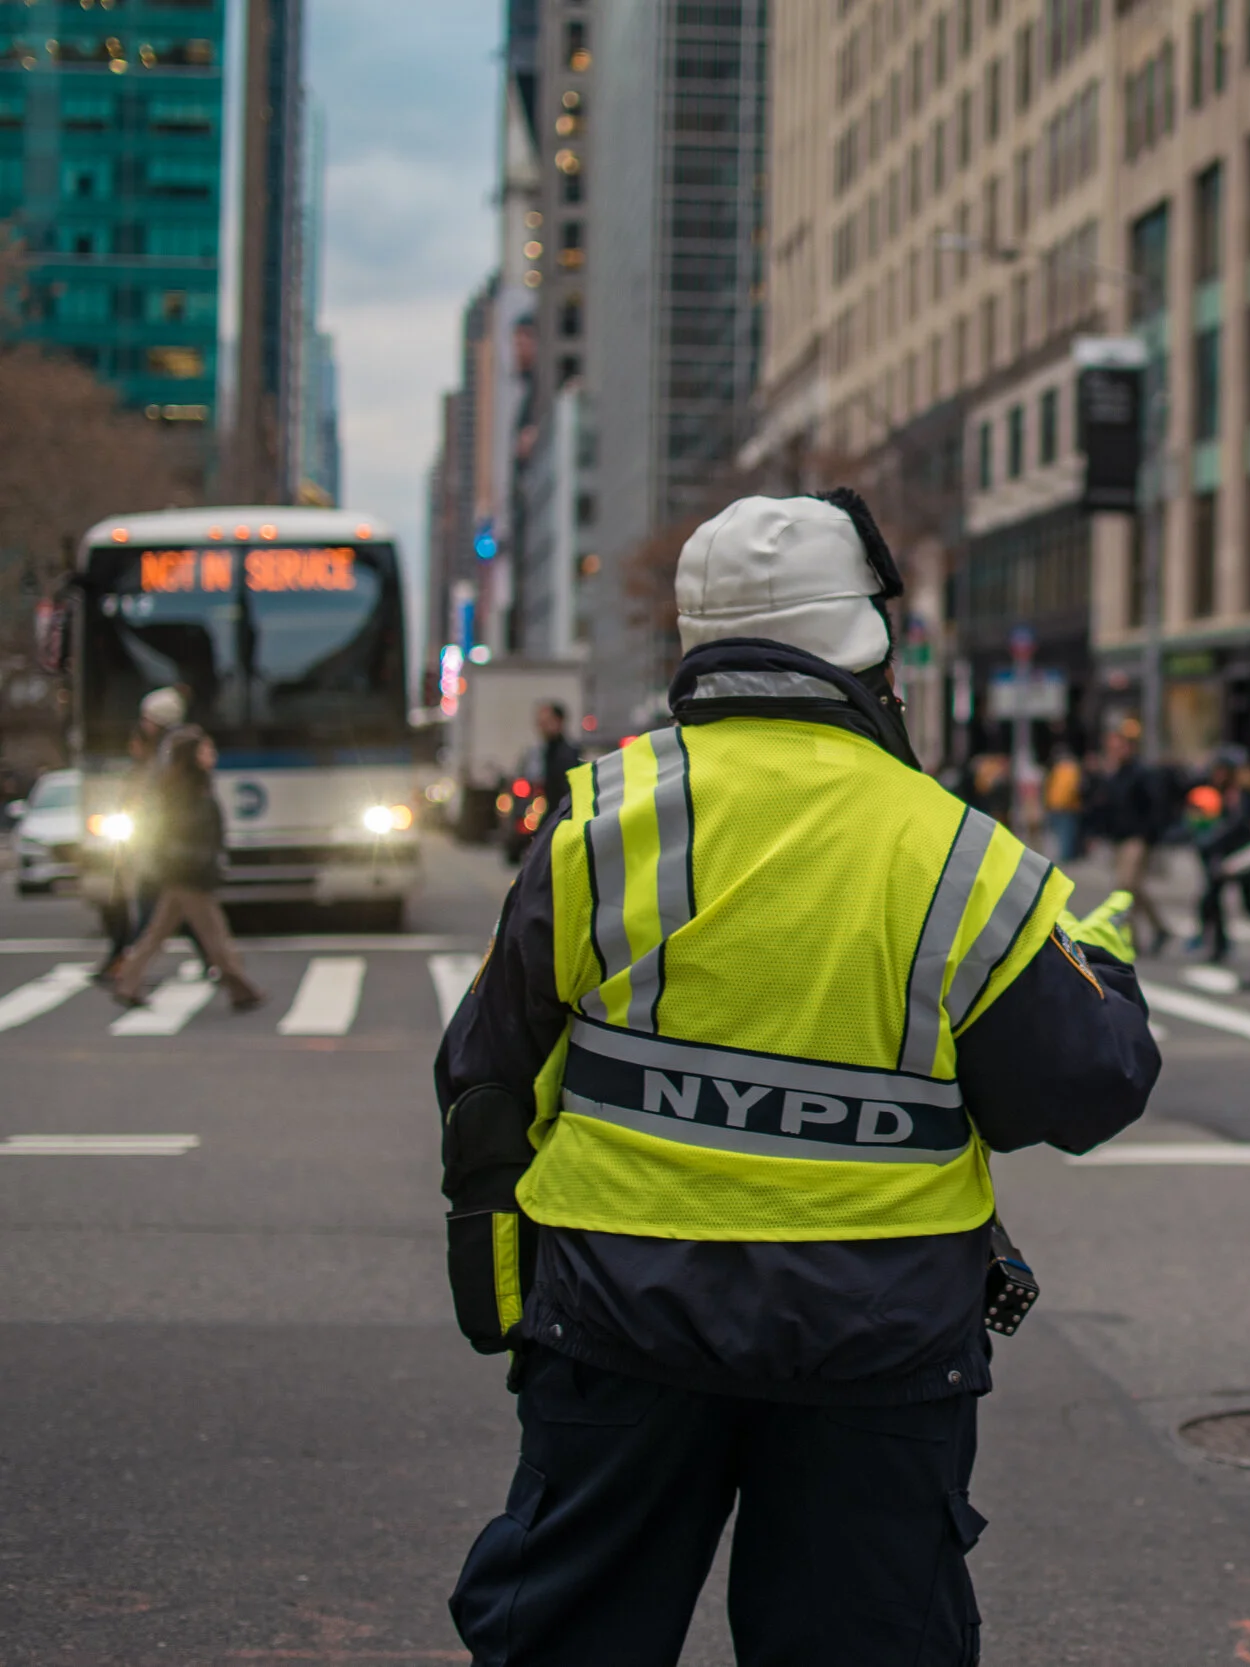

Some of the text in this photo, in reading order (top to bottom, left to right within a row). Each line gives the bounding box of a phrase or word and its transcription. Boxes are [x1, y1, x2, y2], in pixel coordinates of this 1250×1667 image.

[141, 548, 357, 592] NOT IN SERVICE
[641, 1069, 915, 1144] NYPD
